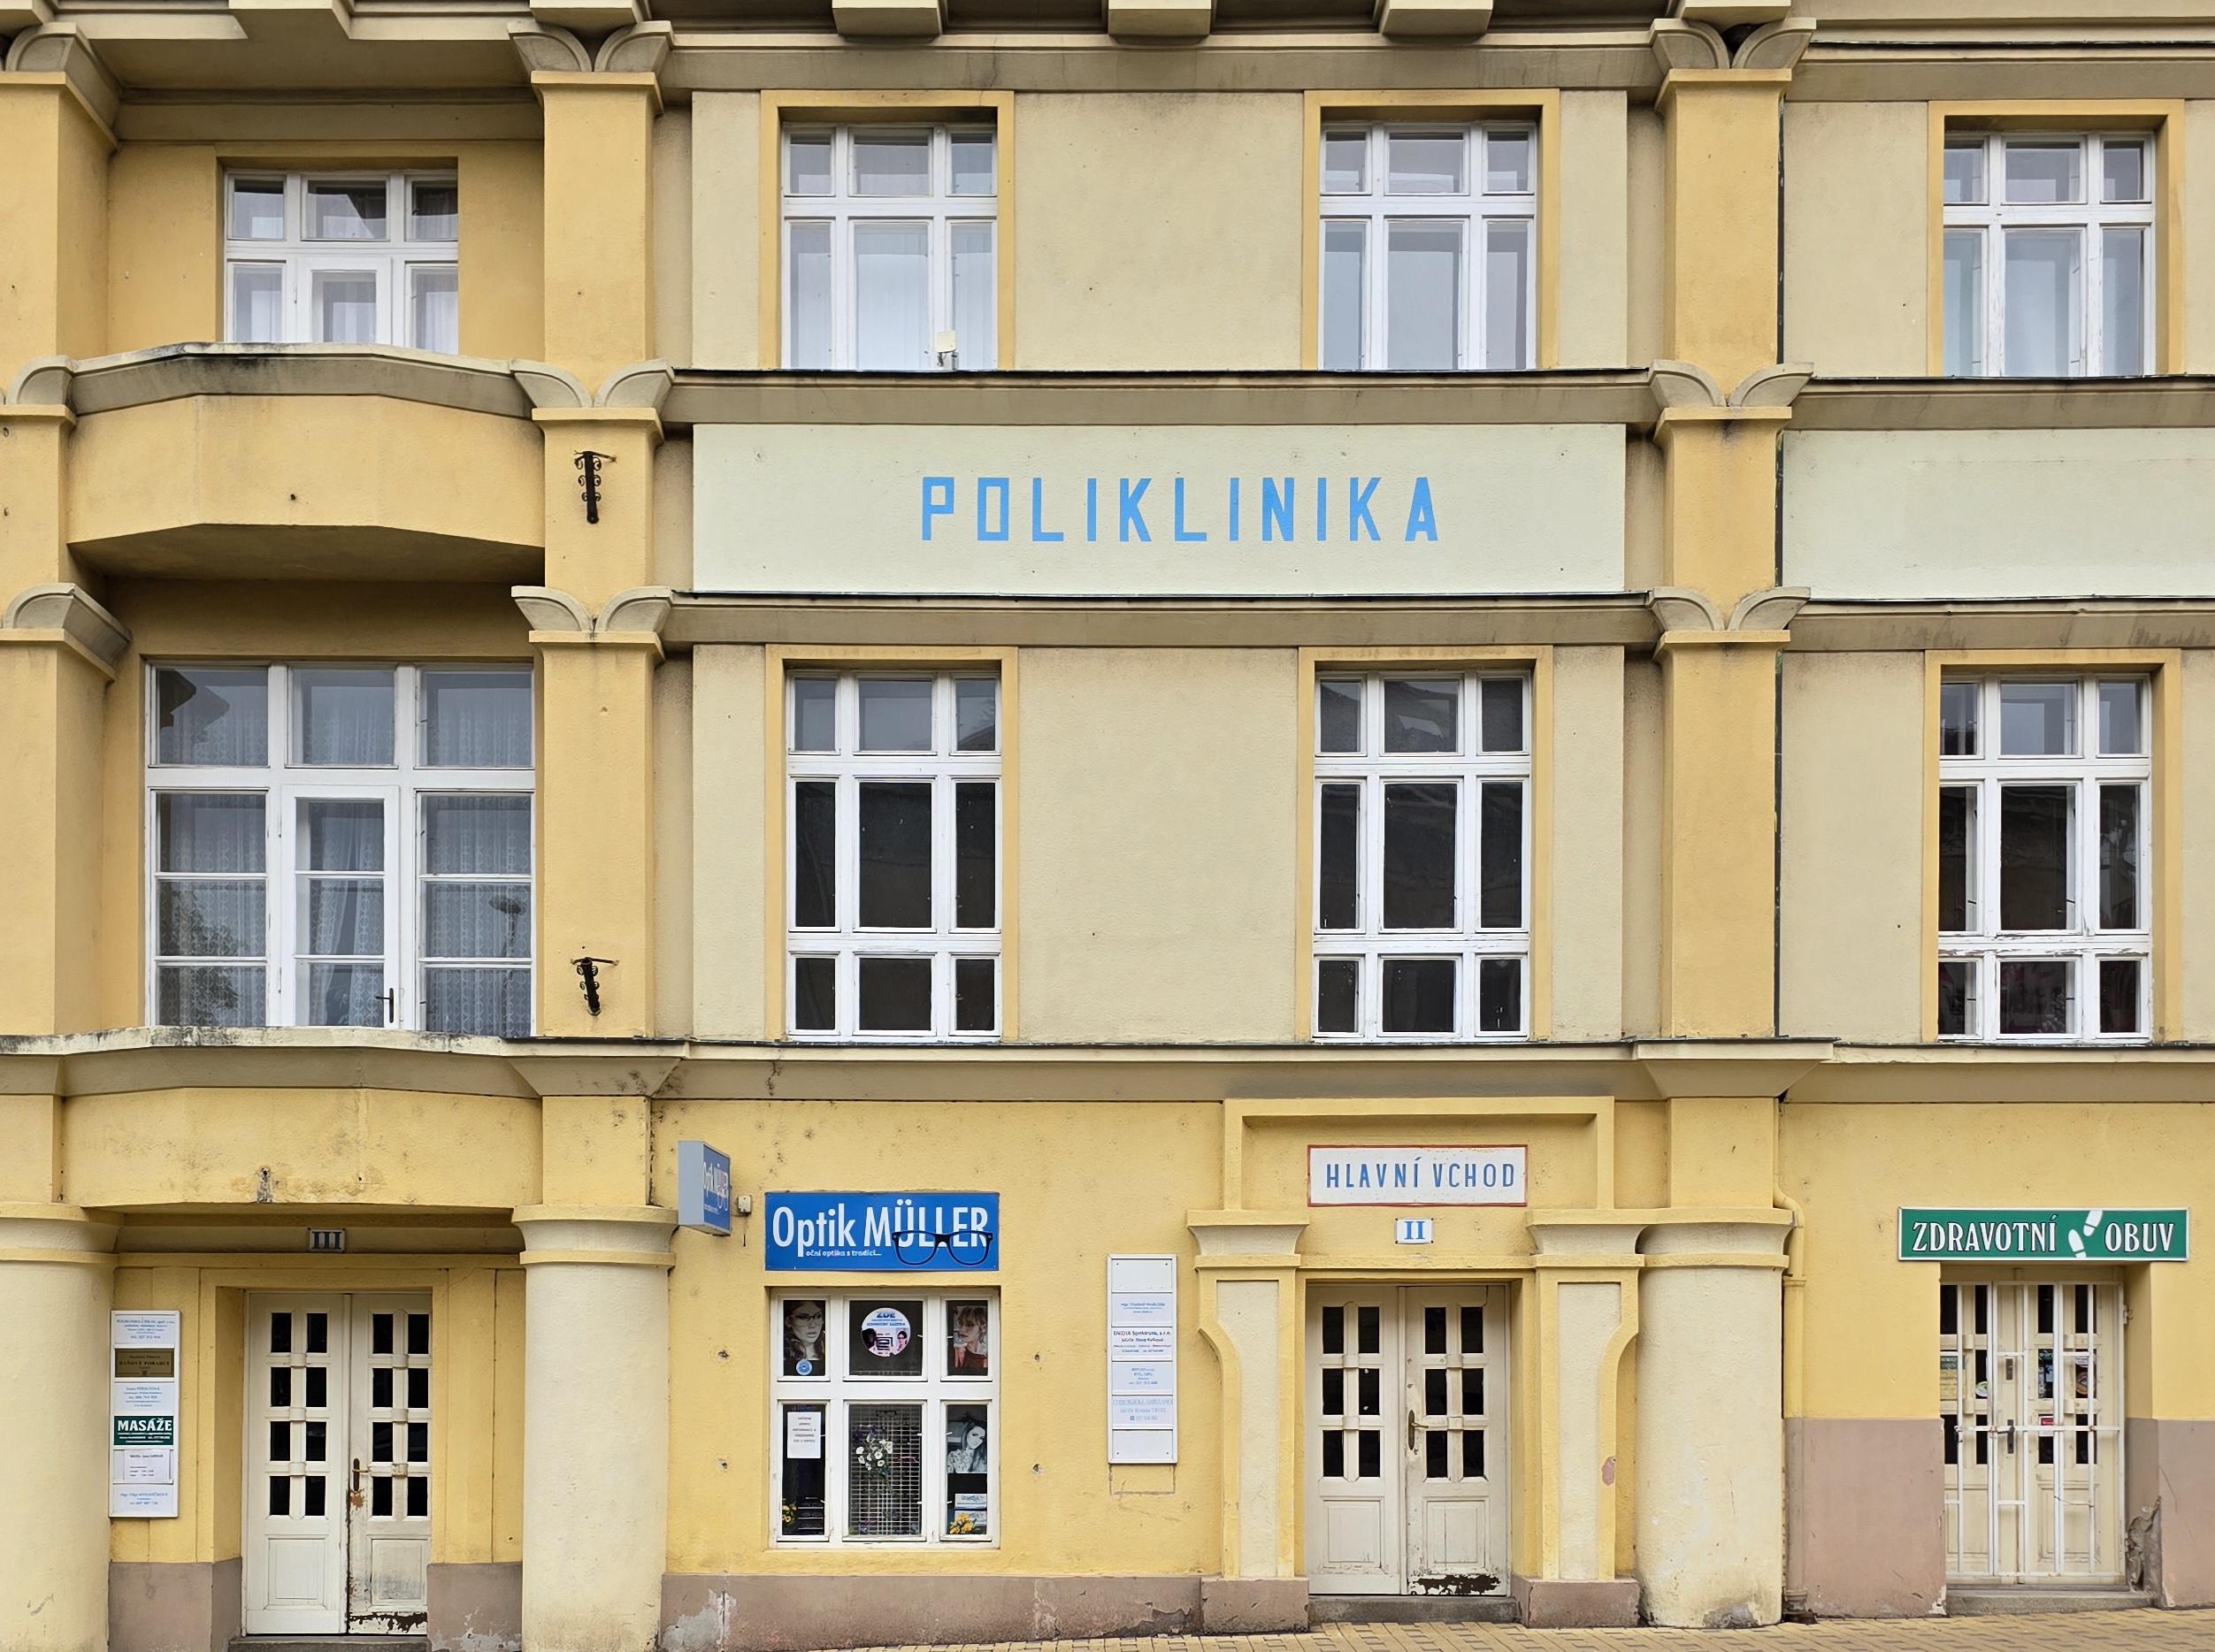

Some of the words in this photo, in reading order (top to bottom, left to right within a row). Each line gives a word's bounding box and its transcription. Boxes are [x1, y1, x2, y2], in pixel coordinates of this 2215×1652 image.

[922, 476, 1438, 543] POLIKLINIKA
[1326, 1156, 1422, 1188] HLAVNÍ
[1432, 1163, 1514, 1188] VCHOD
[772, 1203, 856, 1258] Optik
[863, 1198, 989, 1248] MÜLLER
[1404, 1220, 1426, 1240] II
[1912, 1214, 2058, 1252] ZDRAVOTNÍ
[2104, 1222, 2174, 1252] OBUV
[117, 1418, 172, 1431] MASÁŽE
